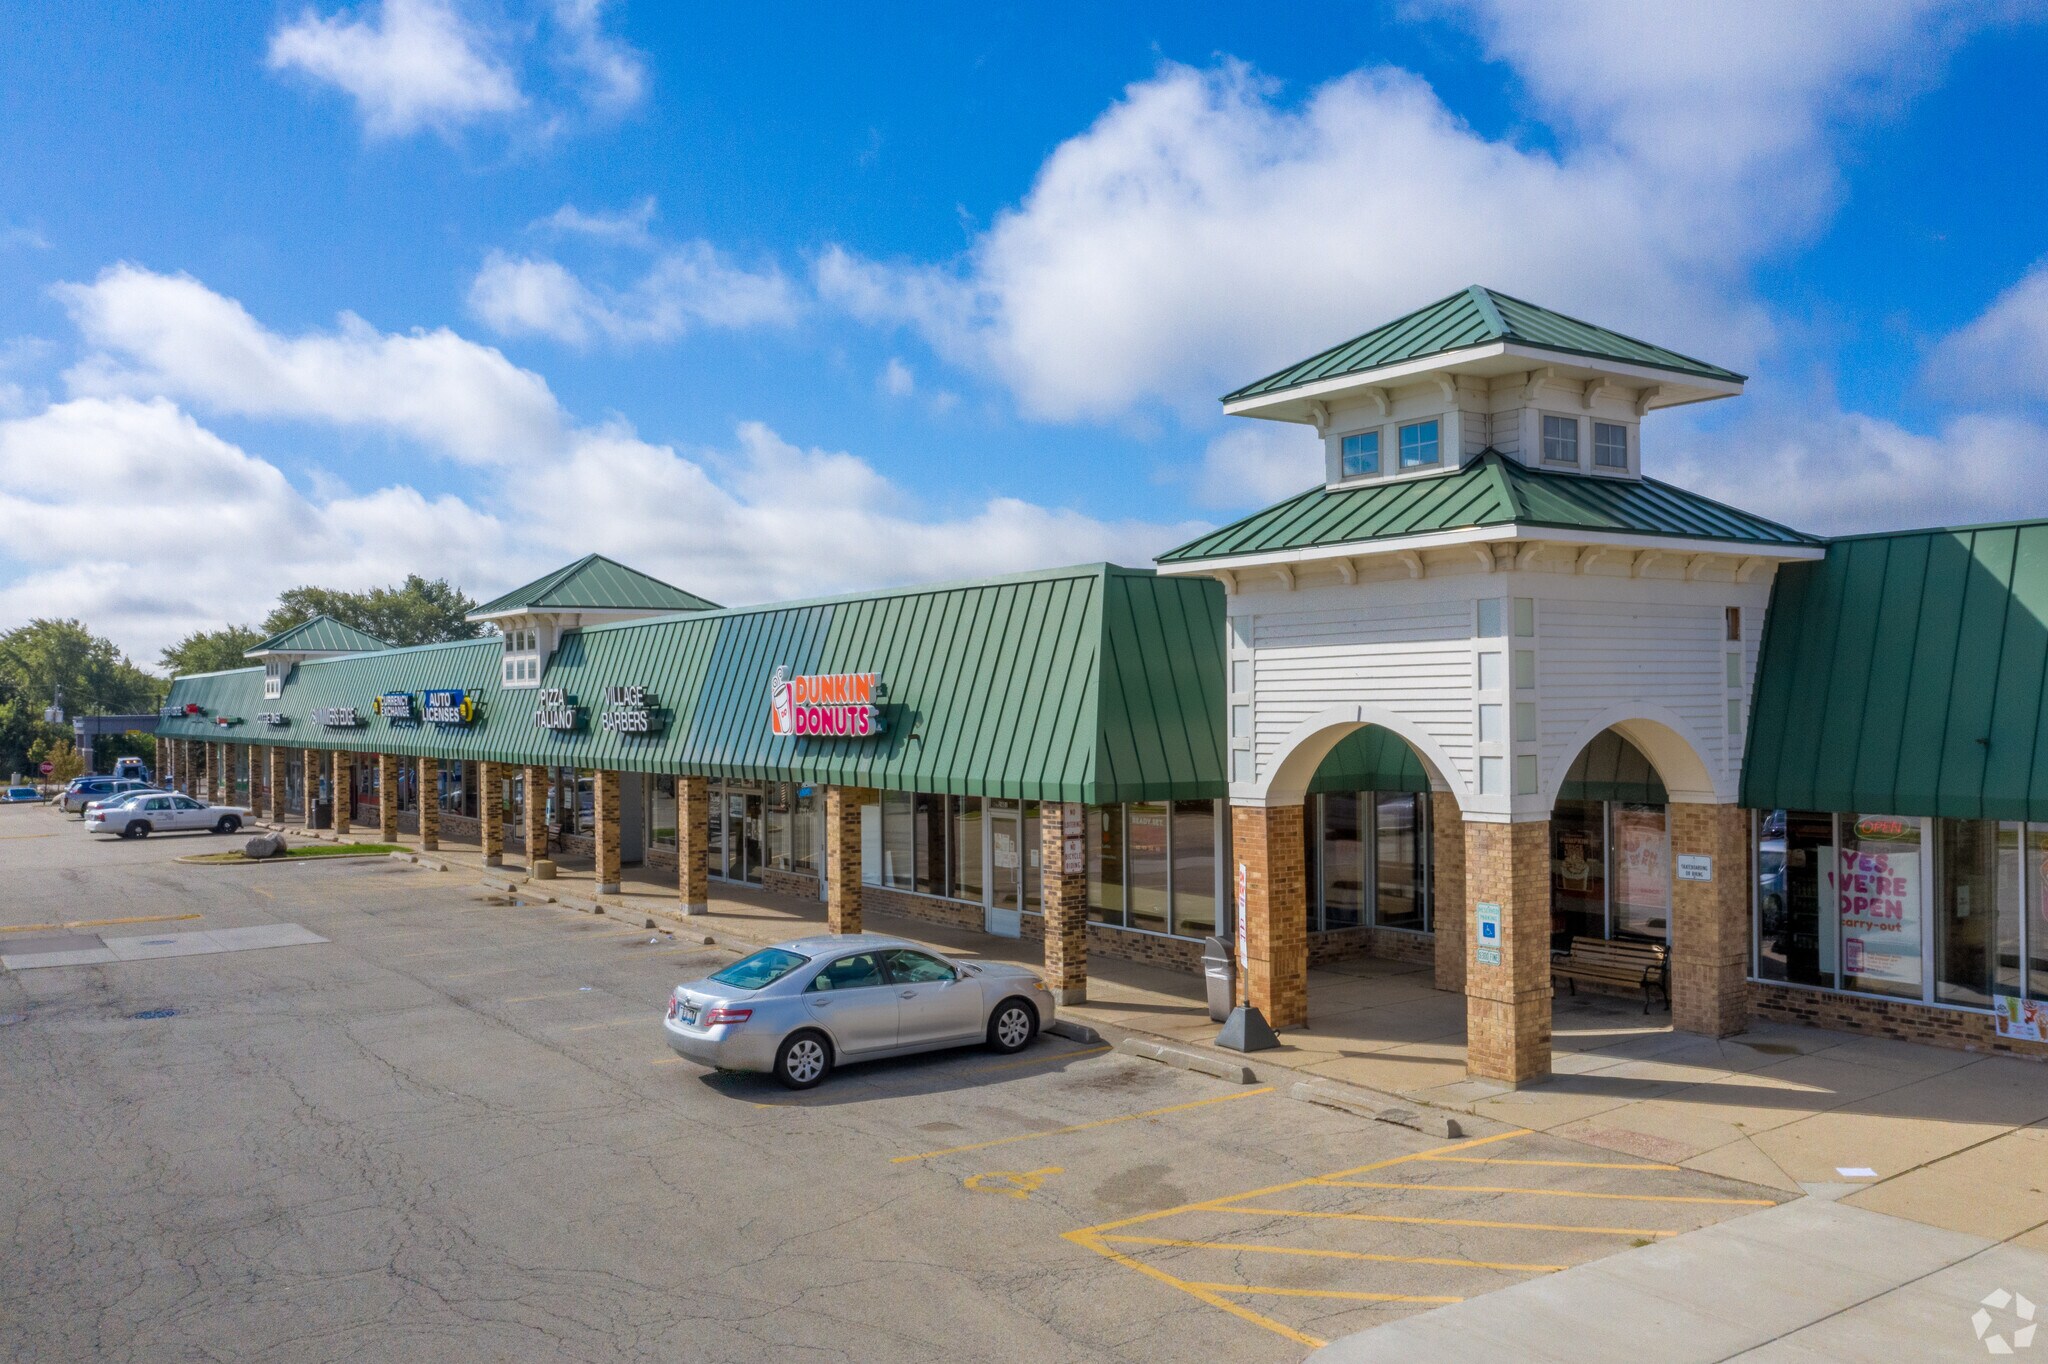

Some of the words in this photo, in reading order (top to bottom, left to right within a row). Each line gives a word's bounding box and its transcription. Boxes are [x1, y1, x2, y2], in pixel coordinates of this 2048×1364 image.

[541, 688, 565, 706] PIZZA
[604, 686, 644, 706] VILLAGE
[796, 674, 875, 704] DUNKIN'
[380, 695, 409, 706] CURRENCY
[429, 693, 451, 707] AUTO
[380, 706, 410, 717] EXCHANGE
[421, 708, 460, 722] LICENSES
[534, 710, 573, 729] ITALIANO
[602, 711, 648, 731] BARBERS
[796, 706, 869, 736] DONUTS
[1861, 820, 1903, 834] OPEN
[1841, 850, 1894, 876] YES,
[1828, 871, 1907, 897] WE'RE
[1840, 895, 1903, 919] OPEN
